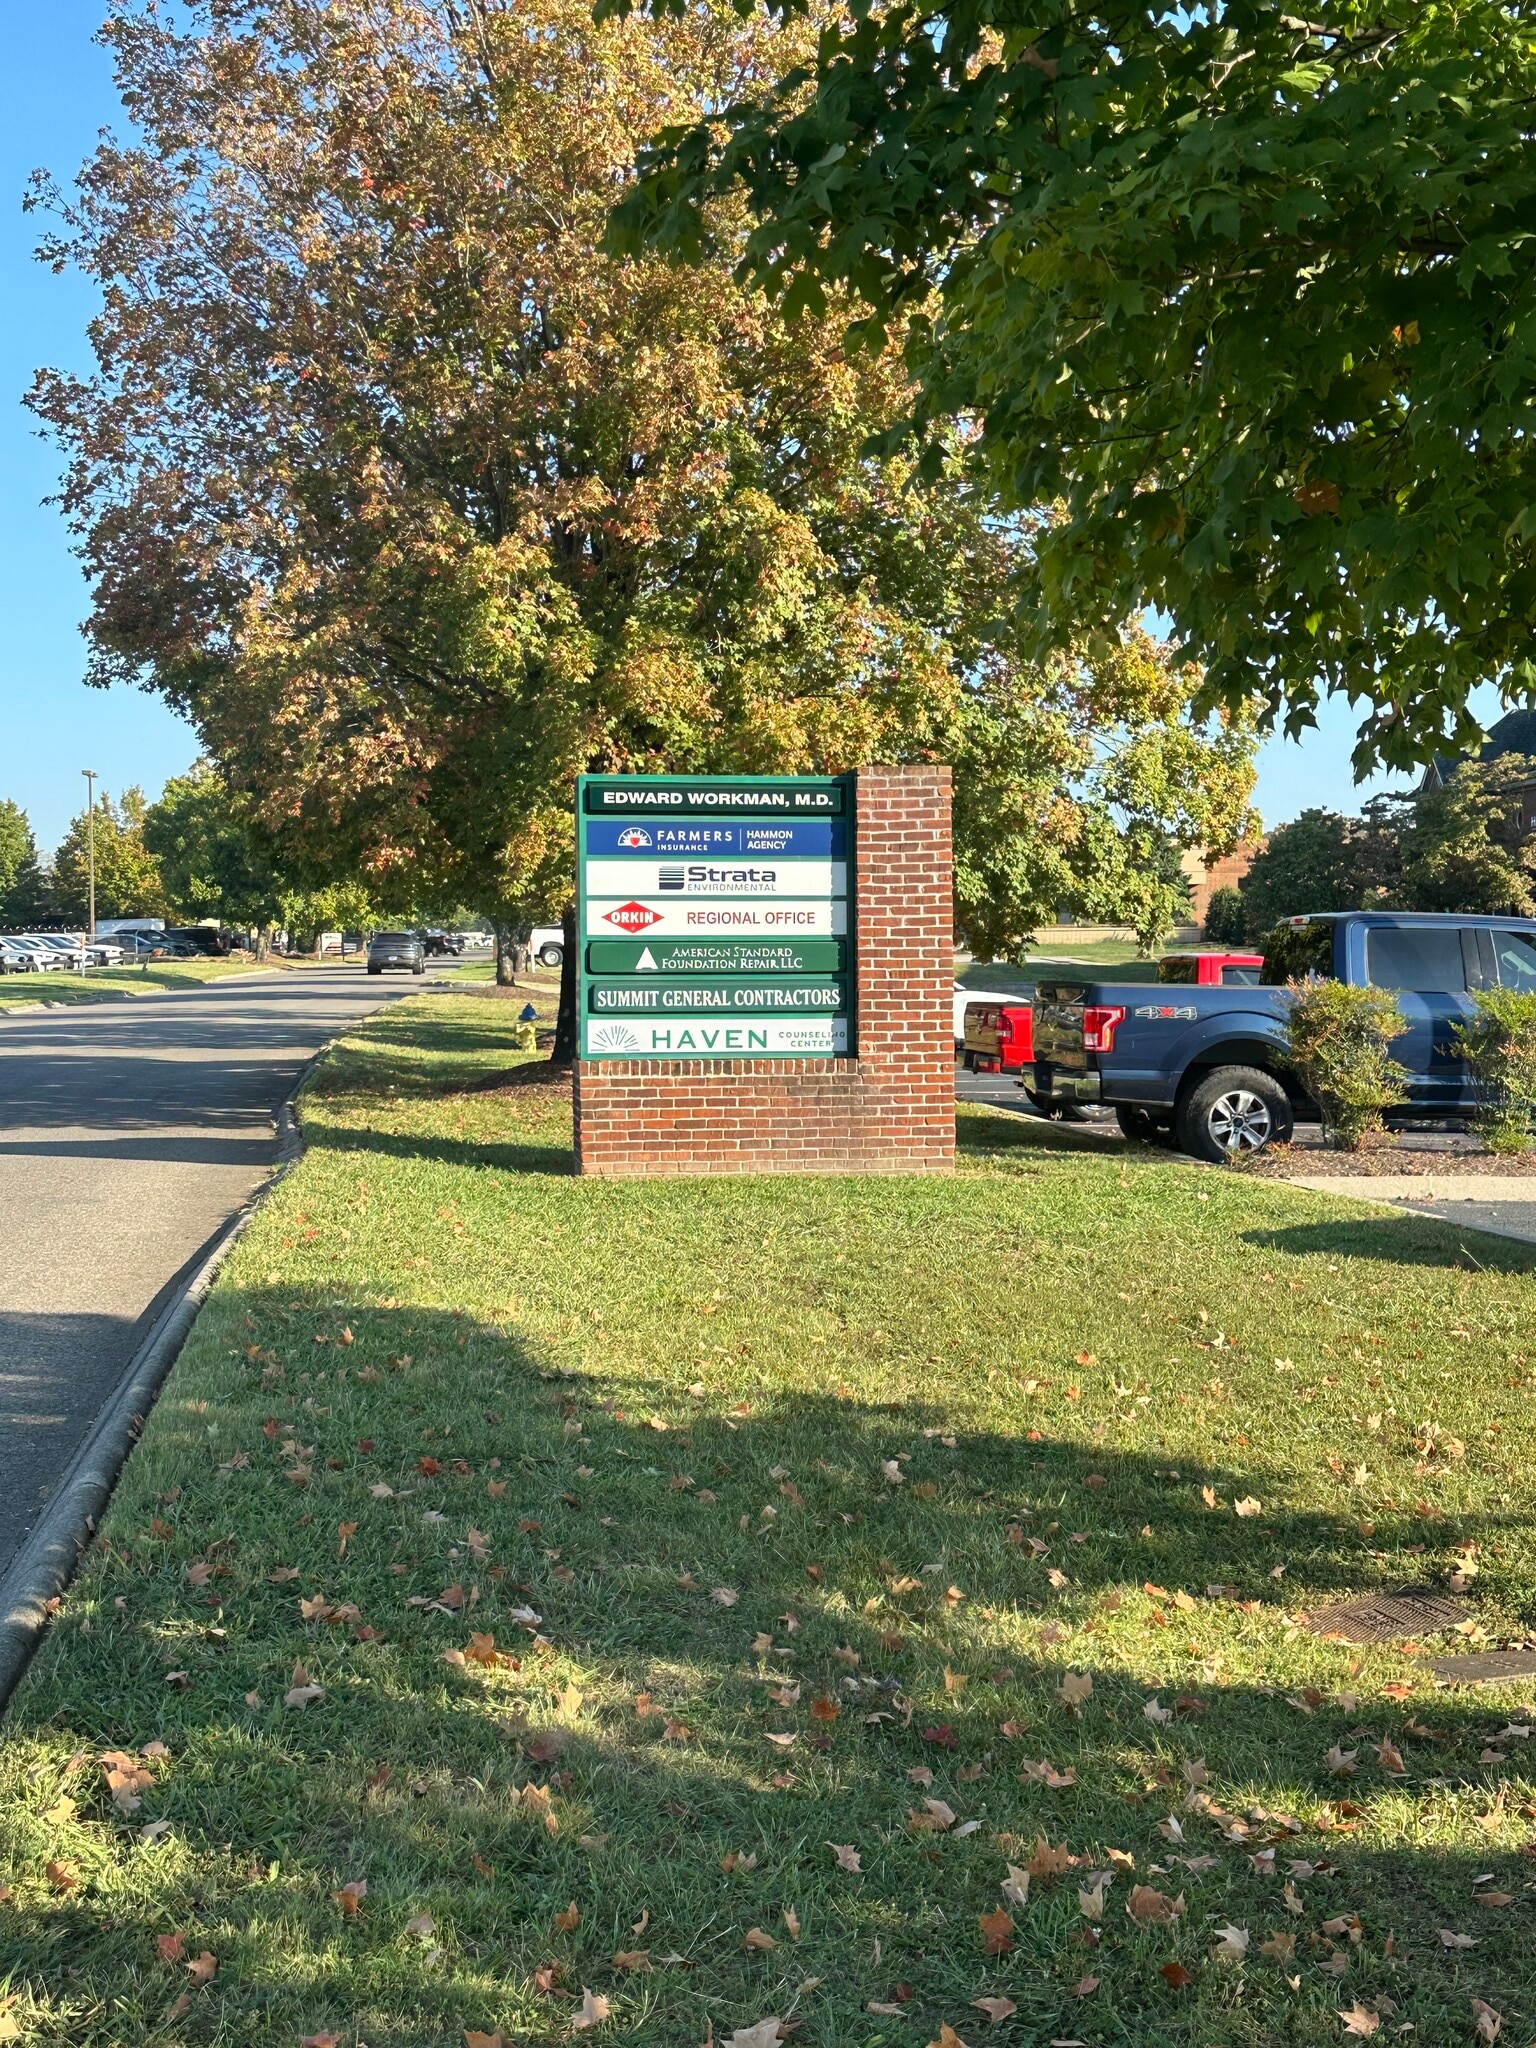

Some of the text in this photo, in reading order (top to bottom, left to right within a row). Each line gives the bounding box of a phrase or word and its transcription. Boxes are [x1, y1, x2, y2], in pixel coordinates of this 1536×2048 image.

[603, 792, 833, 807] EDWARD WORKMAN, M.D.
[657, 830, 733, 841] FARMERS
[747, 830, 793, 839] HAMMON
[747, 841, 787, 850] AGENCY
[688, 866, 776, 882] Strata
[688, 883, 777, 892] ENVIRONMENTAL
[611, 911, 654, 923] ORKIN
[687, 912, 815, 925] REGIONAL OFFICE
[672, 947, 793, 957] AMERICAN STANDARD
[662, 958, 803, 969] FOUNDATION REPAIR LLC
[597, 988, 840, 1007] SUMMIT GENERAL CONTRACTORS
[652, 1029, 767, 1049] HAVEN
